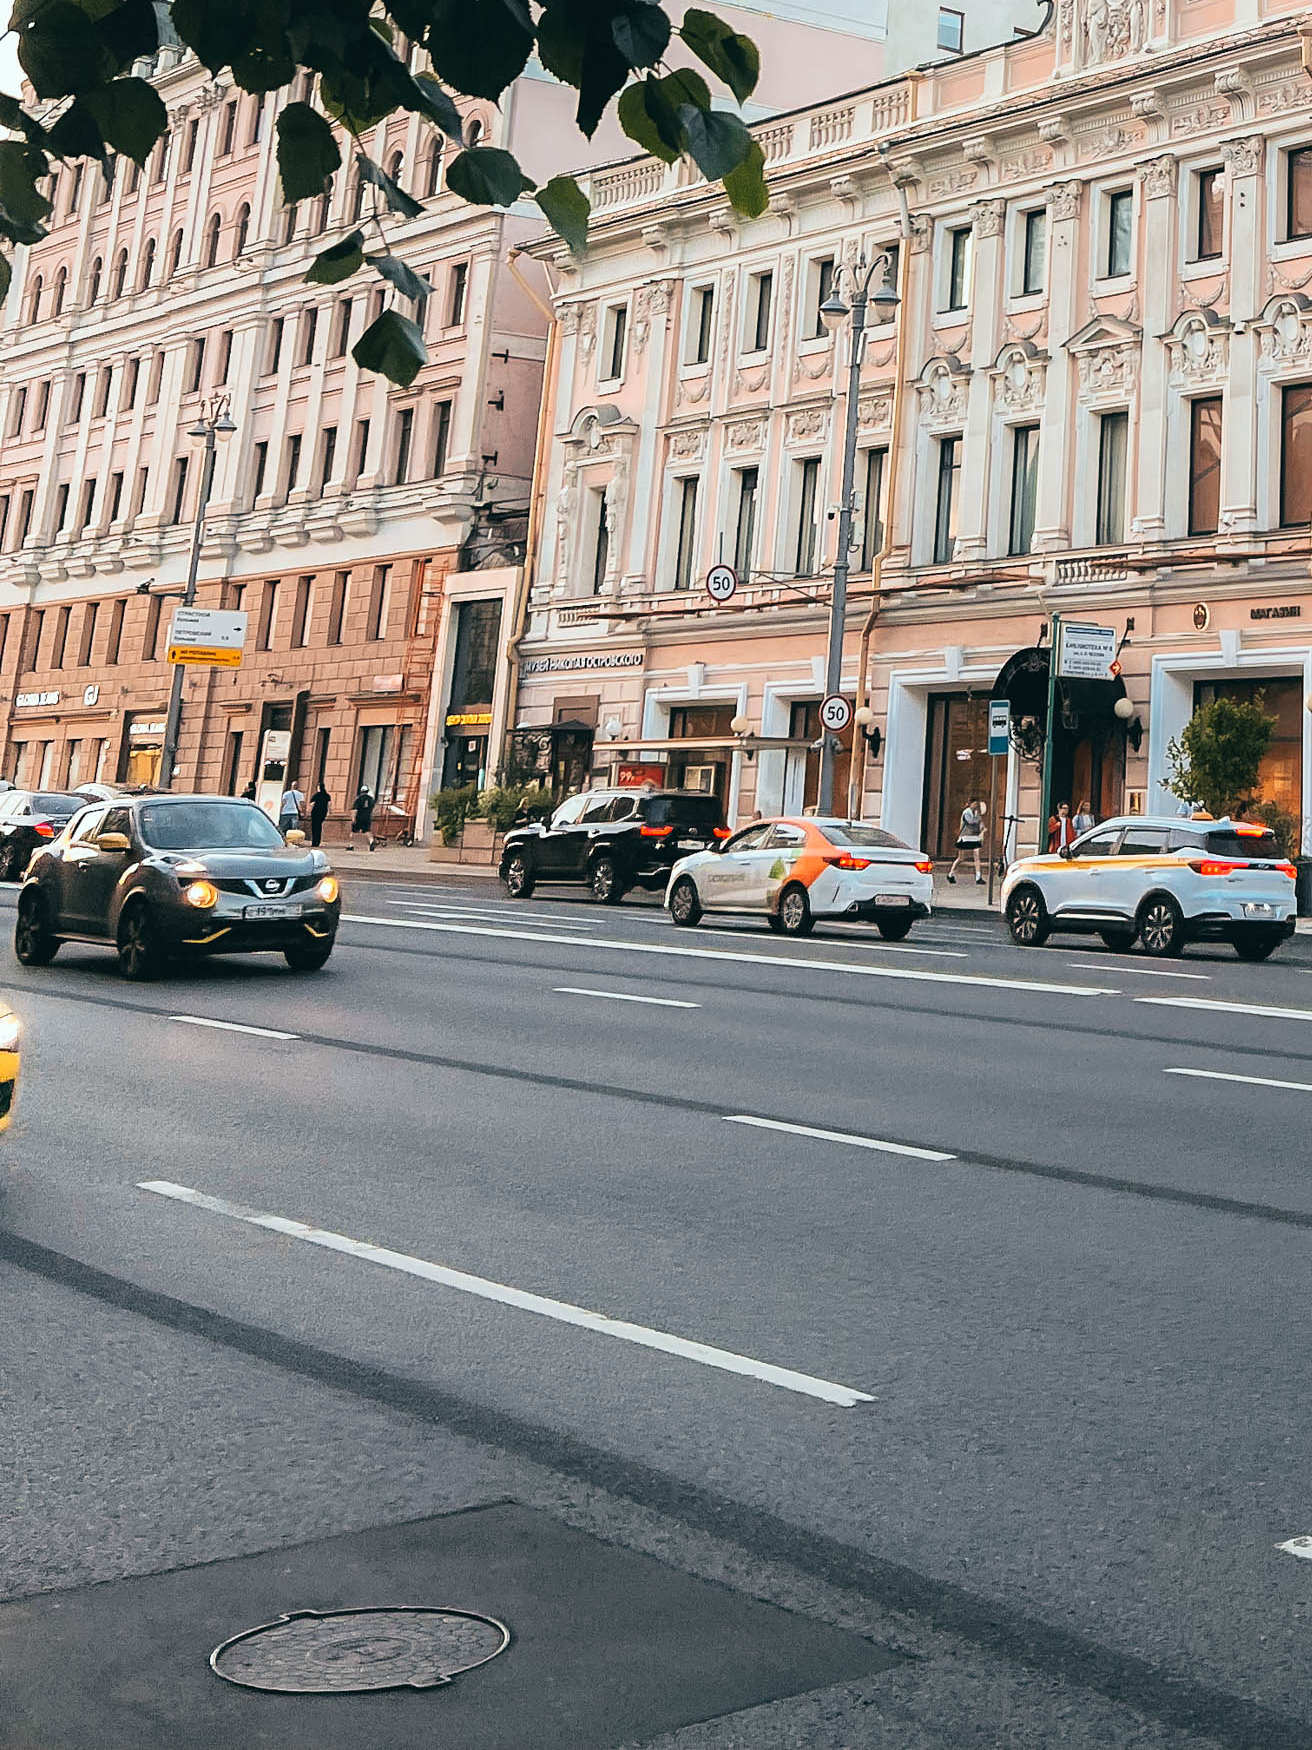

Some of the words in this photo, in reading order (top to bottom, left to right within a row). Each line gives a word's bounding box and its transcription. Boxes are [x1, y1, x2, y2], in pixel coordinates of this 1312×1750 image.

[713, 576, 730, 591] 50
[1250, 606, 1301, 619] МАГАЗИН
[827, 706, 844, 721] 50
